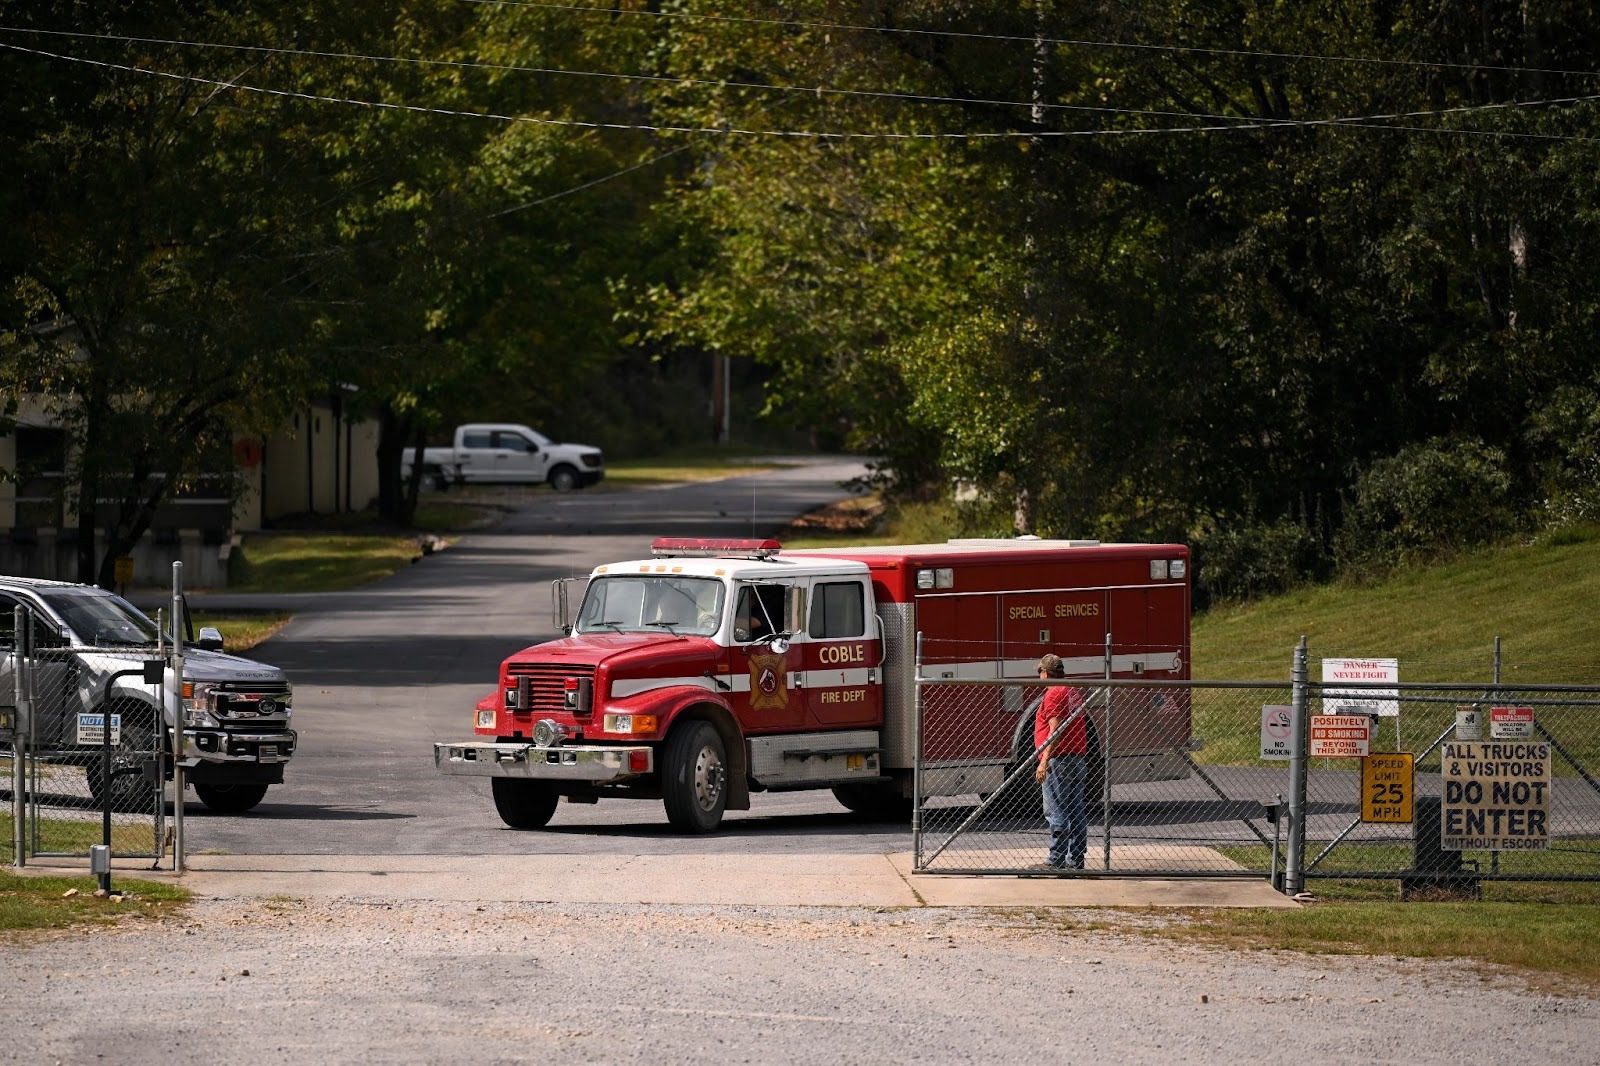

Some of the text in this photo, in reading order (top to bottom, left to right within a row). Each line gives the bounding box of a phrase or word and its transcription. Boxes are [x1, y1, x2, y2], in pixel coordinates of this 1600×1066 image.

[1009, 603, 1099, 620] SPECIAL SERVICES
[819, 644, 865, 664] COBLE
[840, 671, 845, 684] 1
[1333, 671, 1388, 679] NEVER FIGHT
[821, 690, 866, 704] FIRE DEPT
[80, 716, 118, 725] NOTIE
[1313, 717, 1366, 726] POSITIVELY
[1314, 731, 1365, 739] NO SMOKING
[1263, 748, 1291, 756] SMOKIN
[1445, 744, 1548, 760] ALL TRUCKS
[1371, 760, 1404, 769] SPEED
[1450, 761, 1544, 776] & VISITORS
[1374, 771, 1401, 780] LIMIT
[1371, 783, 1404, 804] 25
[1446, 781, 1547, 805] DO NOT
[1373, 807, 1401, 818] MPH
[1446, 808, 1547, 836] ENTER
[1443, 838, 1547, 849] WITHOUT ESCORT
